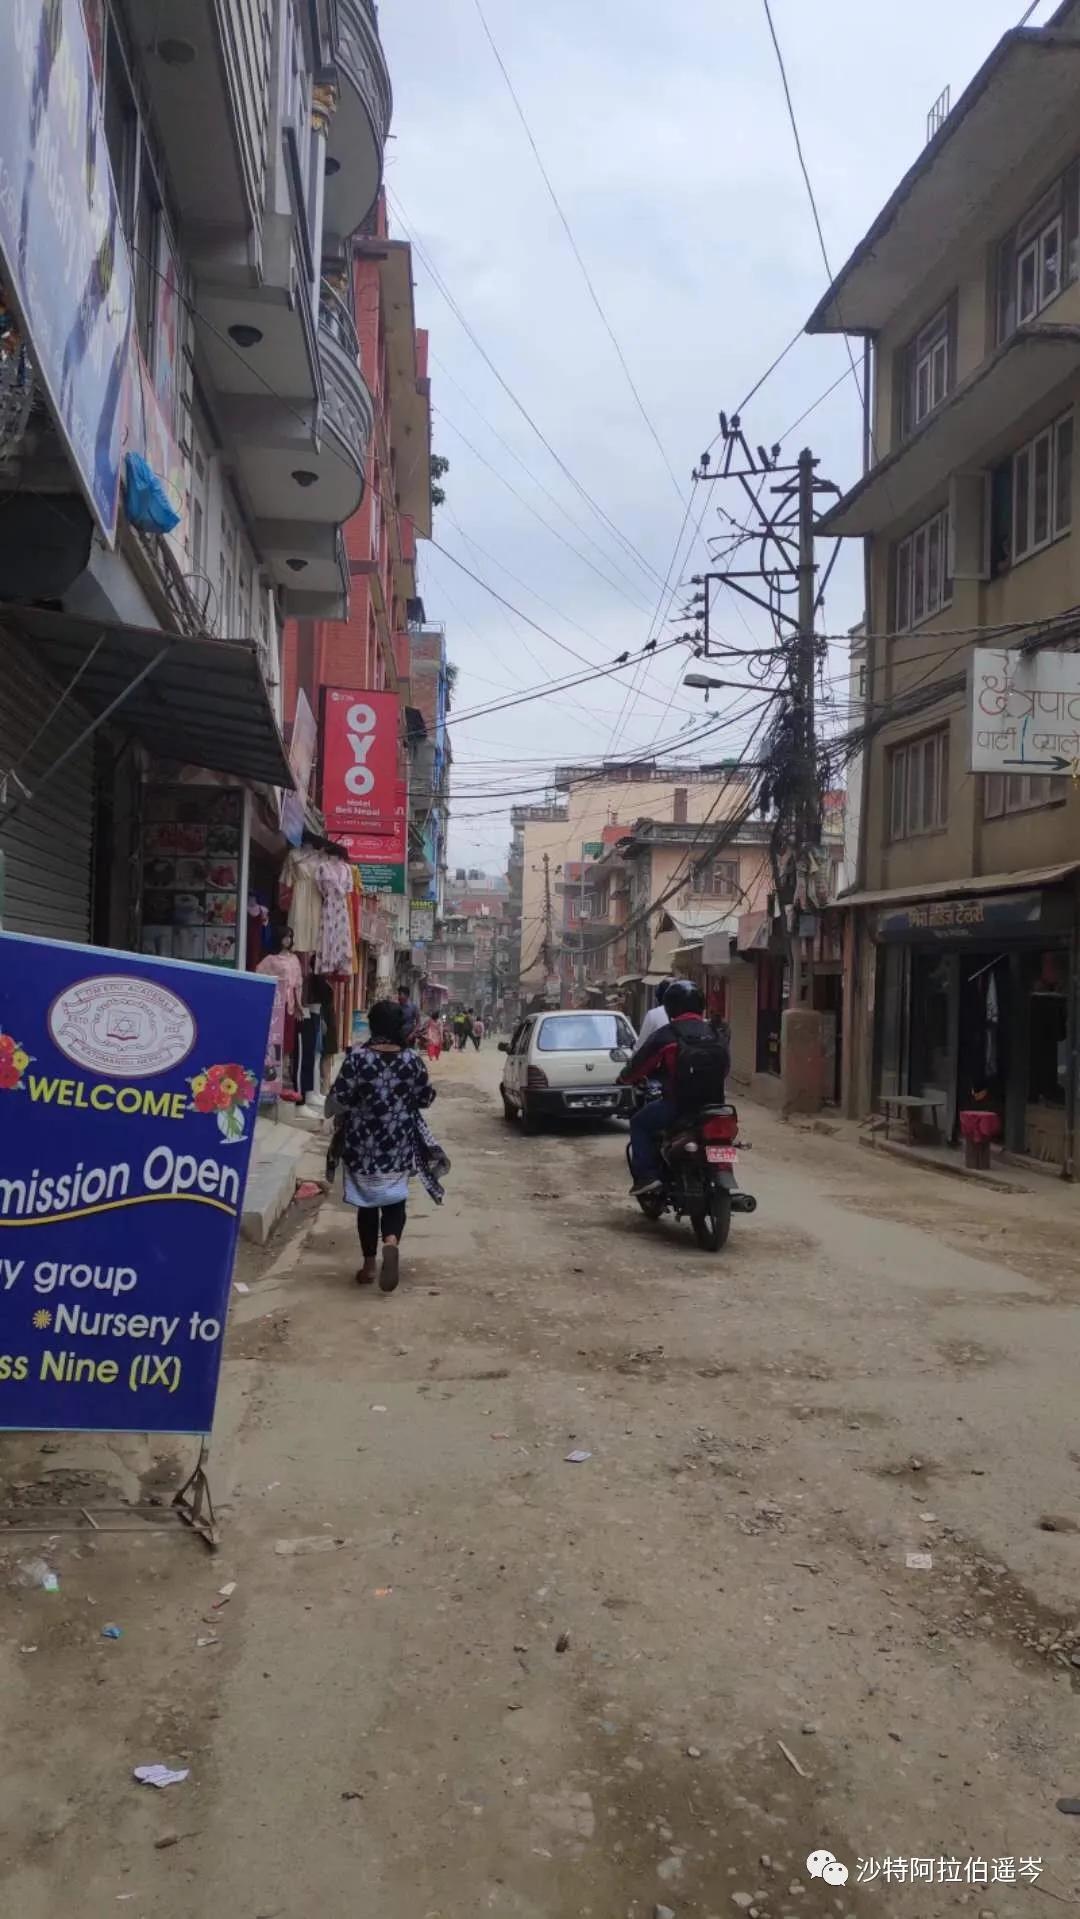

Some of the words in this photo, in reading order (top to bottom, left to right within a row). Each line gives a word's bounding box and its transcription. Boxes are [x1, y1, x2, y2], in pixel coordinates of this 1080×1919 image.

[345, 704, 376, 795] OYO
[28, 1075, 187, 1119] WELCOME
[143, 1146, 240, 1204] Open
[33, 1261, 137, 1296] group
[54, 1304, 180, 1345] Nursery
[189, 1312, 220, 1341] to
[40, 1351, 119, 1383] Nine
[129, 1355, 181, 1392] (IX)
